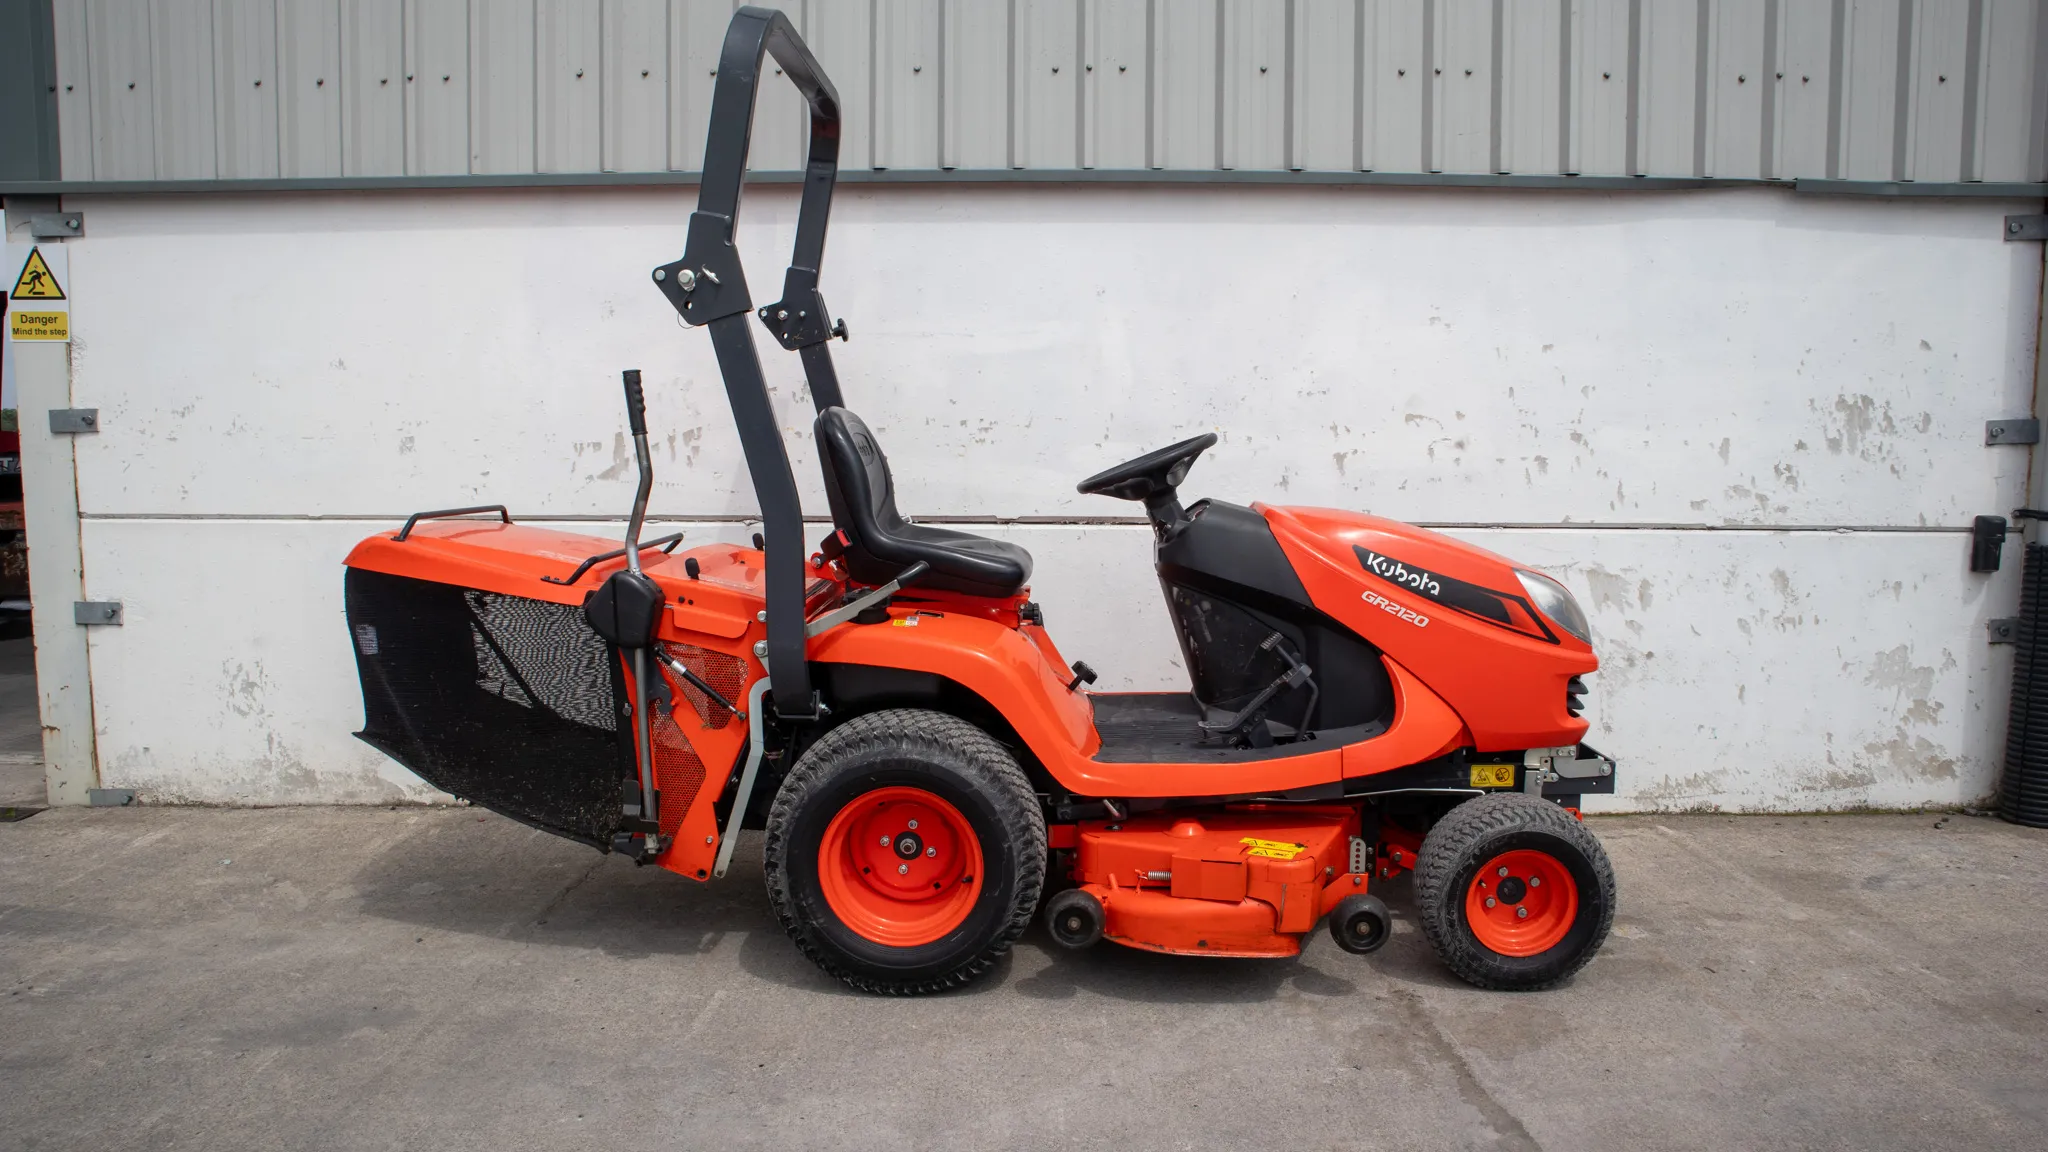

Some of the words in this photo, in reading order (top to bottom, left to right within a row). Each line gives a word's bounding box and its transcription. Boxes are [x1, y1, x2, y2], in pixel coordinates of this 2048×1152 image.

[20, 314, 58, 326] Danger
[50, 328, 67, 337] step
[1367, 552, 1440, 596] Kubota
[1361, 590, 1430, 628] GR2120
